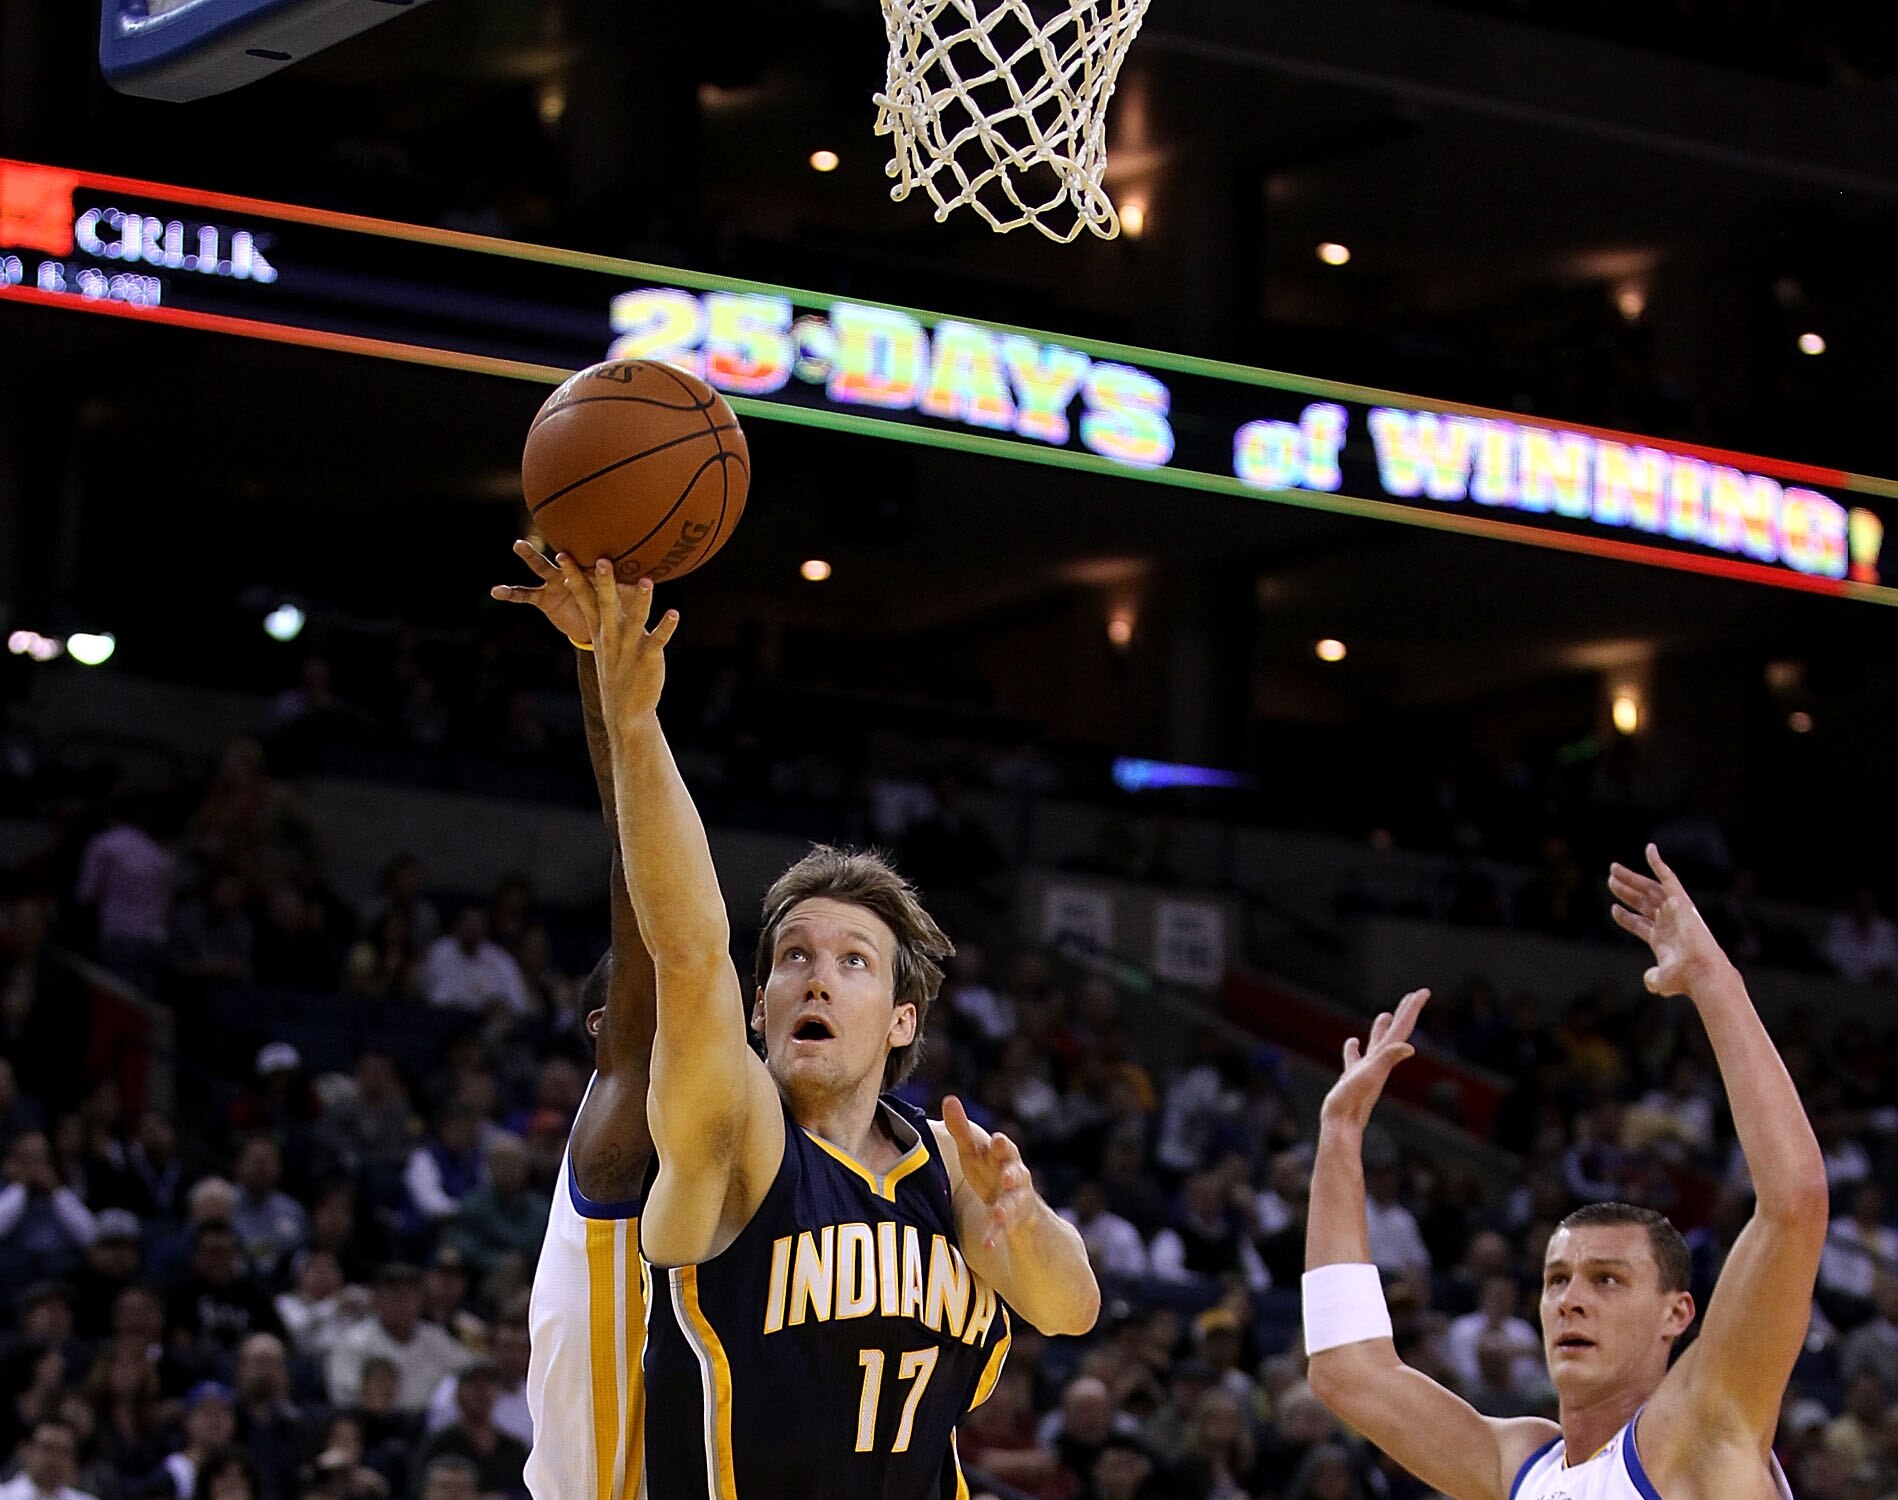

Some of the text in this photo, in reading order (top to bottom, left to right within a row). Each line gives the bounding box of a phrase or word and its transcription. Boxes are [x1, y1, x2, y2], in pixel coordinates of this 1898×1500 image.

[1233, 402, 1349, 493] of
[1367, 405, 1884, 586] WINNING!
[763, 1221, 997, 1348] INDIANA
[854, 1346, 939, 1453] 17
